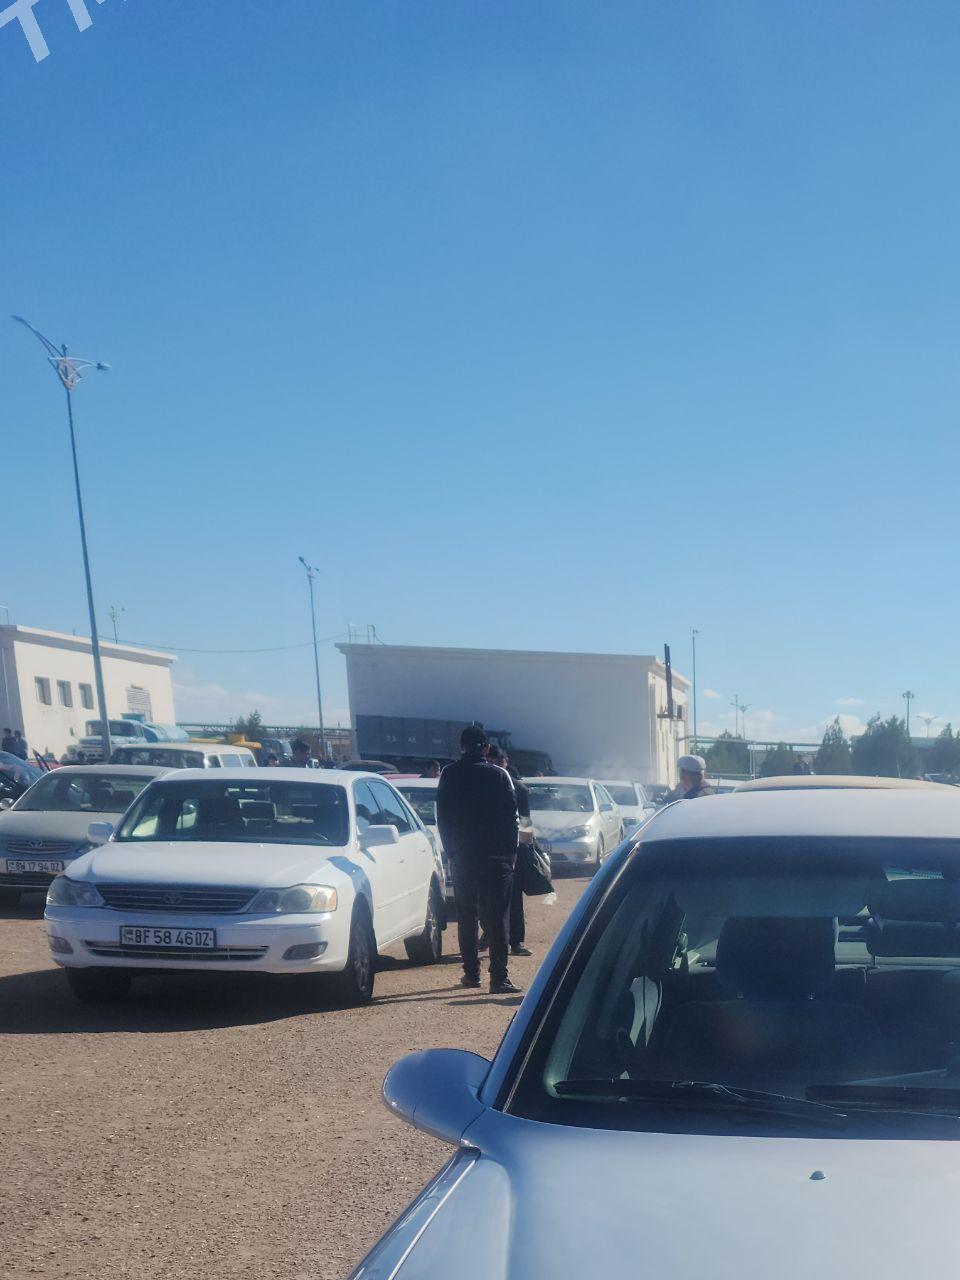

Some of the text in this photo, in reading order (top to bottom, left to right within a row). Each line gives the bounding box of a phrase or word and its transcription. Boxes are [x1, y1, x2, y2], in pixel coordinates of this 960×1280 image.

[135, 929, 150, 944] BF
[153, 930, 172, 945] 58
[175, 931, 194, 946] 46
